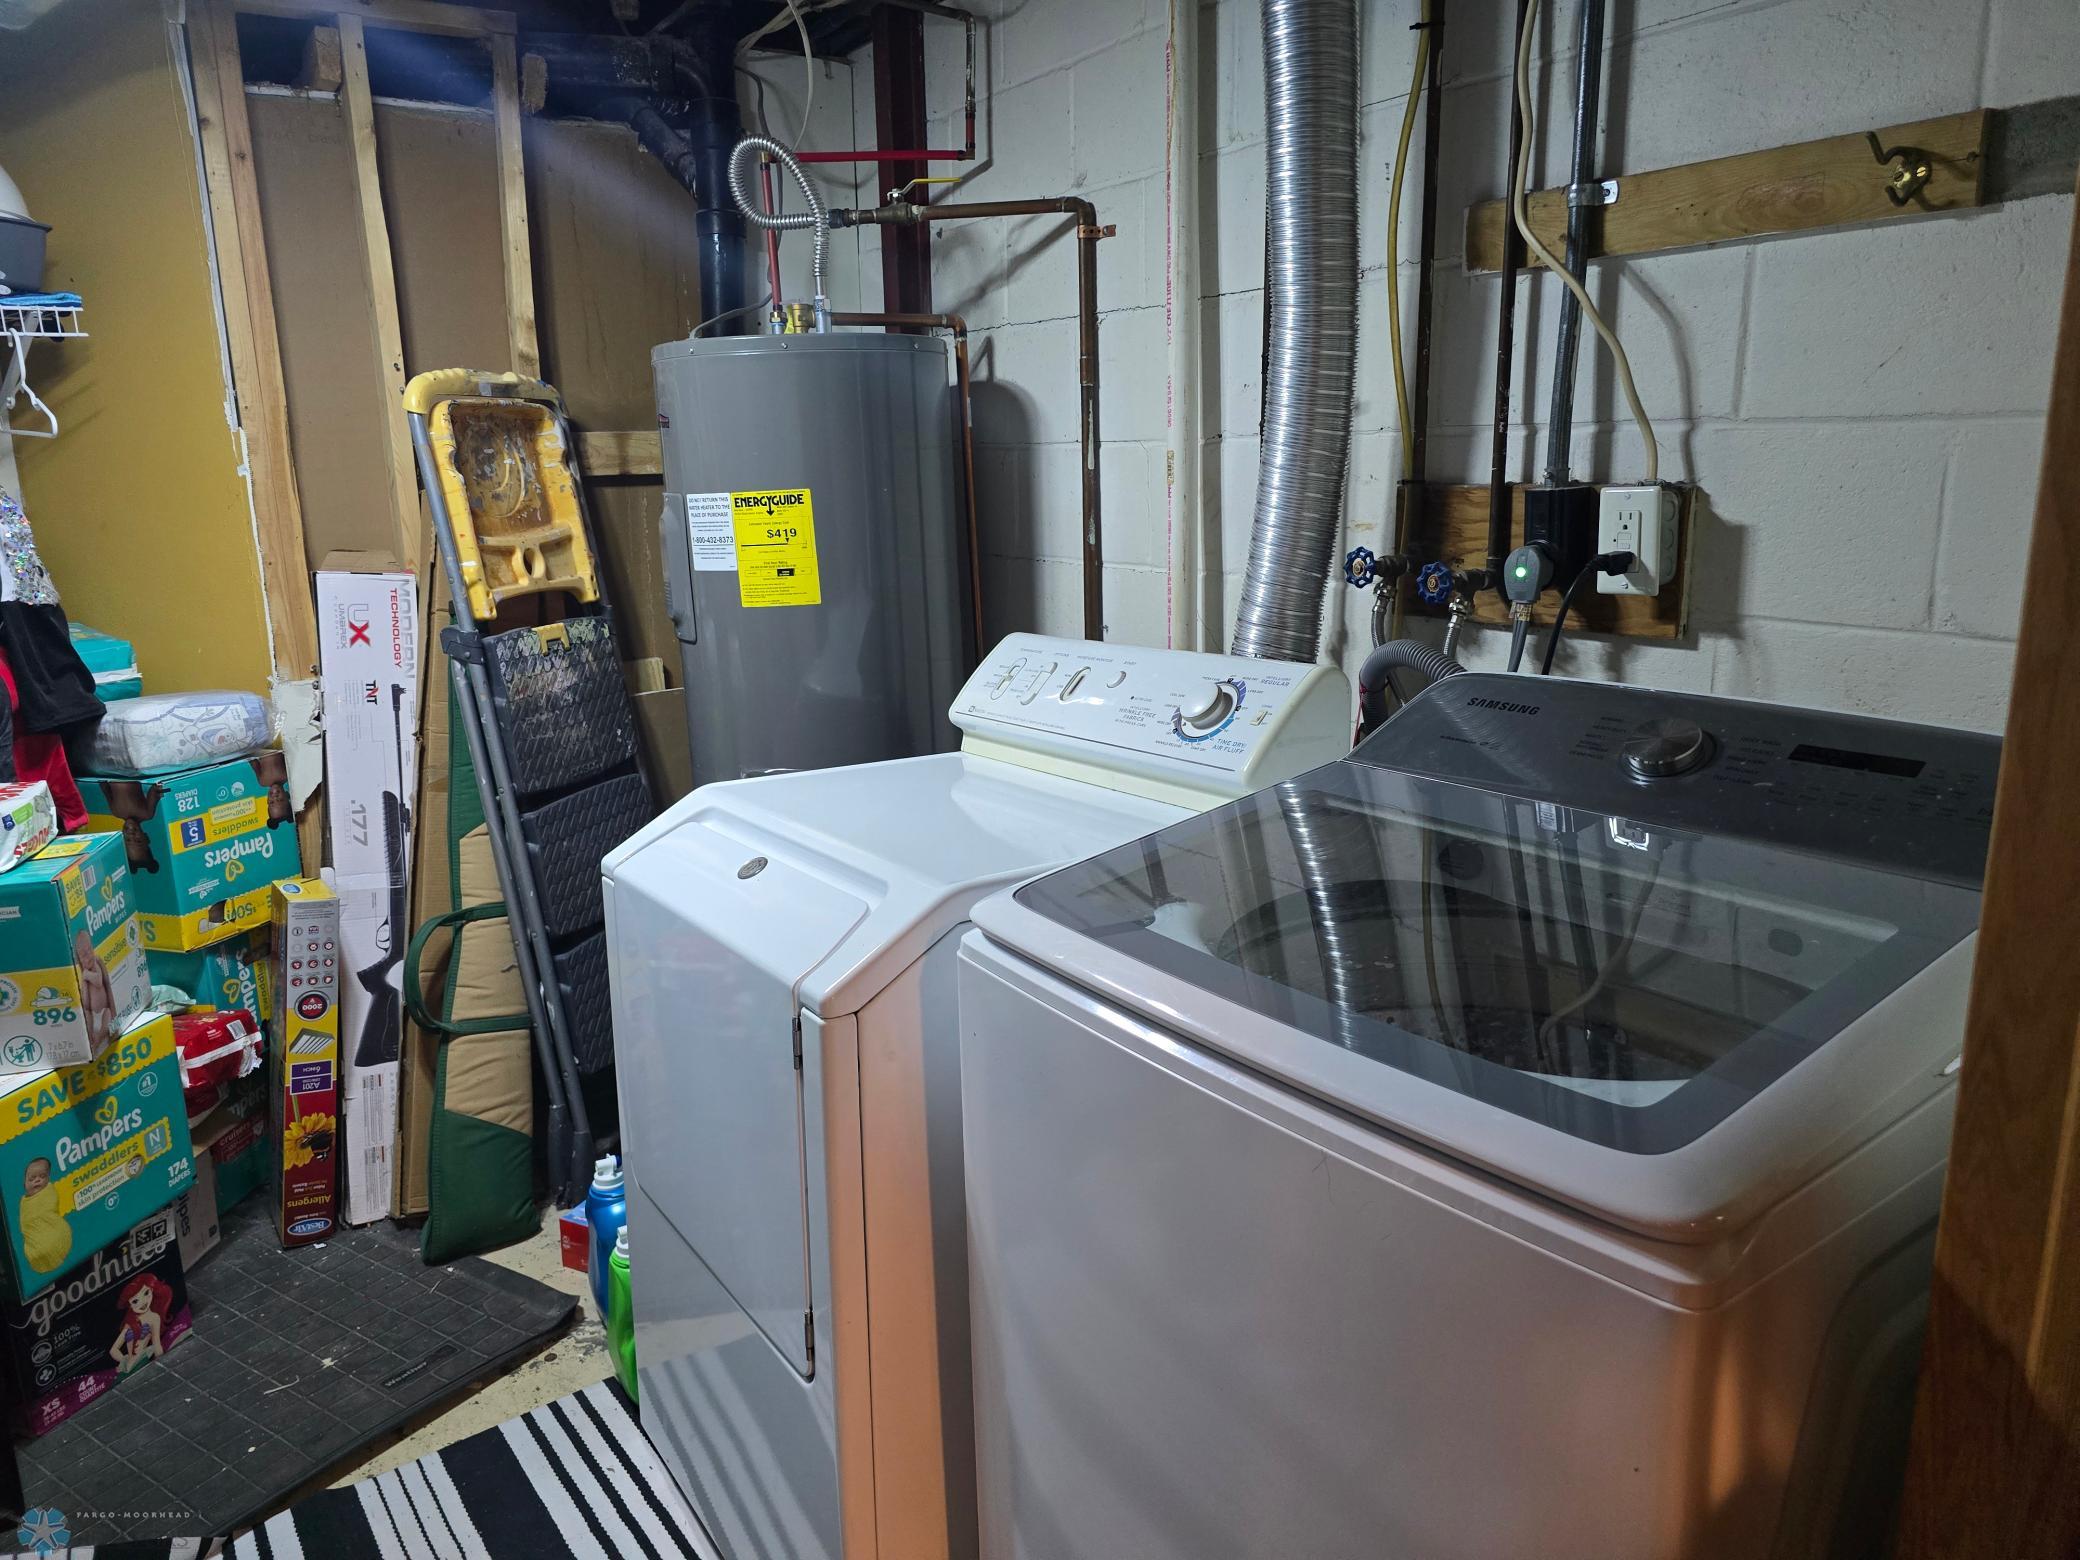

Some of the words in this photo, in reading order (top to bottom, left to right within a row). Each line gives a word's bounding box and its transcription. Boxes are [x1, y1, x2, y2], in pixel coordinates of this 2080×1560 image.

[734, 494, 804, 508] ENERGYGUIDE
[692, 536, 734, 544] 1-800-432-8373
[347, 603, 371, 648] UX
[390, 588, 402, 668] TECHNOLOGY
[399, 579, 415, 678] MODERN
[366, 680, 379, 705] TNT
[1466, 696, 1541, 716] SAMSUNG
[1217, 738, 1232, 746] TIME
[175, 789, 198, 800] DIAPERS
[177, 797, 200, 812] 128
[213, 817, 259, 836] swaddlers
[351, 799, 369, 846] .177
[189, 827, 199, 842] 5
[204, 832, 273, 868] Pampers
[86, 891, 125, 936] Pampers
[33, 1007, 77, 1026] 896
[302, 1003, 323, 1011] 2000
[17, 1072, 85, 1124] SAVE
[97, 1036, 153, 1077] $850
[55, 1107, 143, 1172] Pampers
[149, 1131, 161, 1146] N
[72, 1142, 139, 1188] swaddlers
[168, 1157, 189, 1178] 174
[168, 1168, 191, 1187] DIAPERS
[287, 1194, 331, 1208] Allergens
[78, 1375, 96, 1392] 44
[42, 1398, 61, 1415] XS
